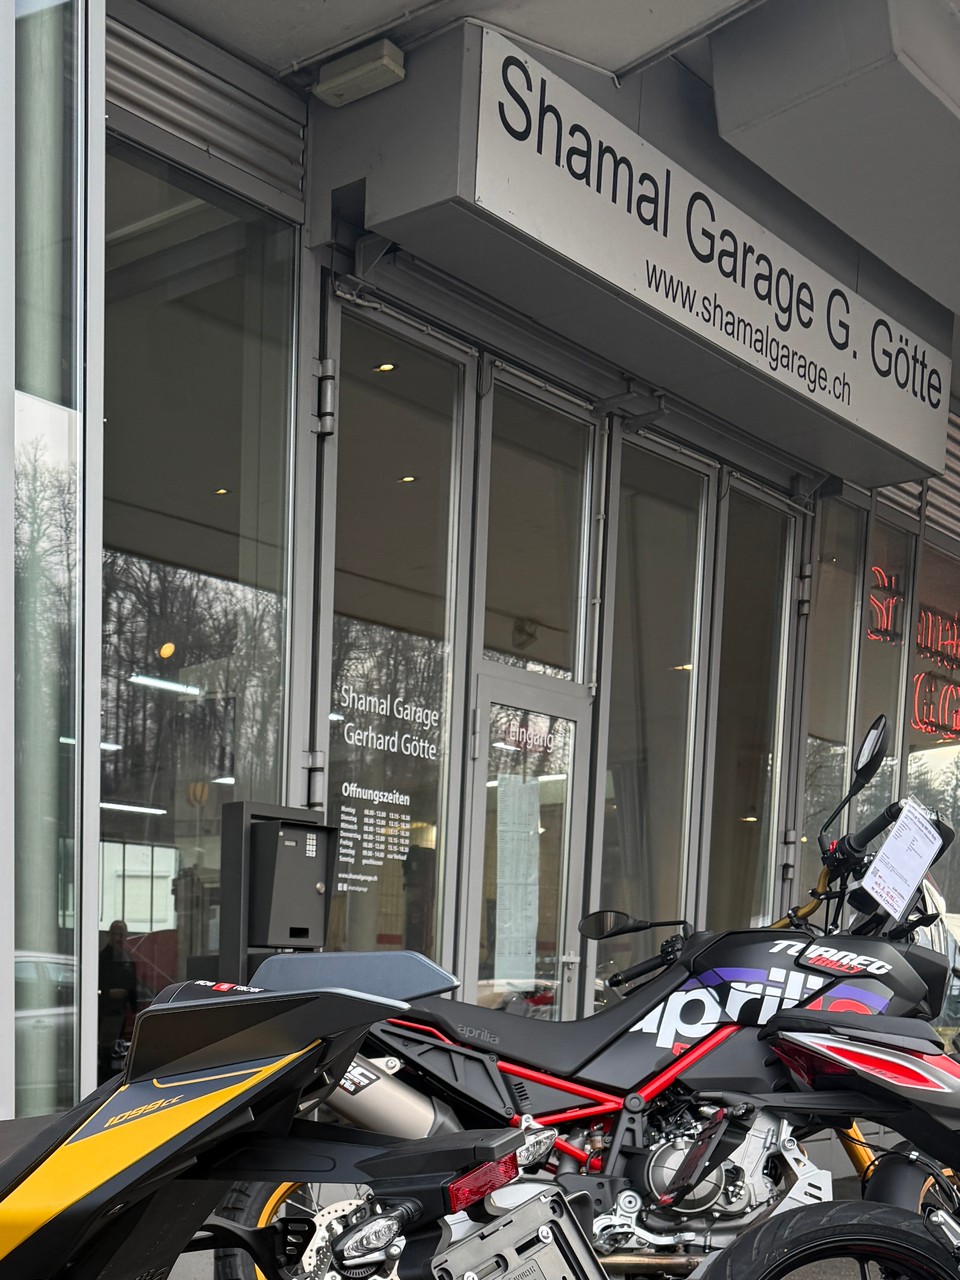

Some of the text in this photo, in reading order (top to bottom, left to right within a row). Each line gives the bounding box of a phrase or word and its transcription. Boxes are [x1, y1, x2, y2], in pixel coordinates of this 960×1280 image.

[498, 55, 943, 411] Shamal Garage G. Götte
[645, 259, 852, 407] www.shamalgarage.ch
[341, 685, 439, 730] Shamal Garage
[344, 722, 437, 760] Gerhard Götte
[509, 721, 554, 753] Eingang
[456, 1023, 500, 1045] aprilia
